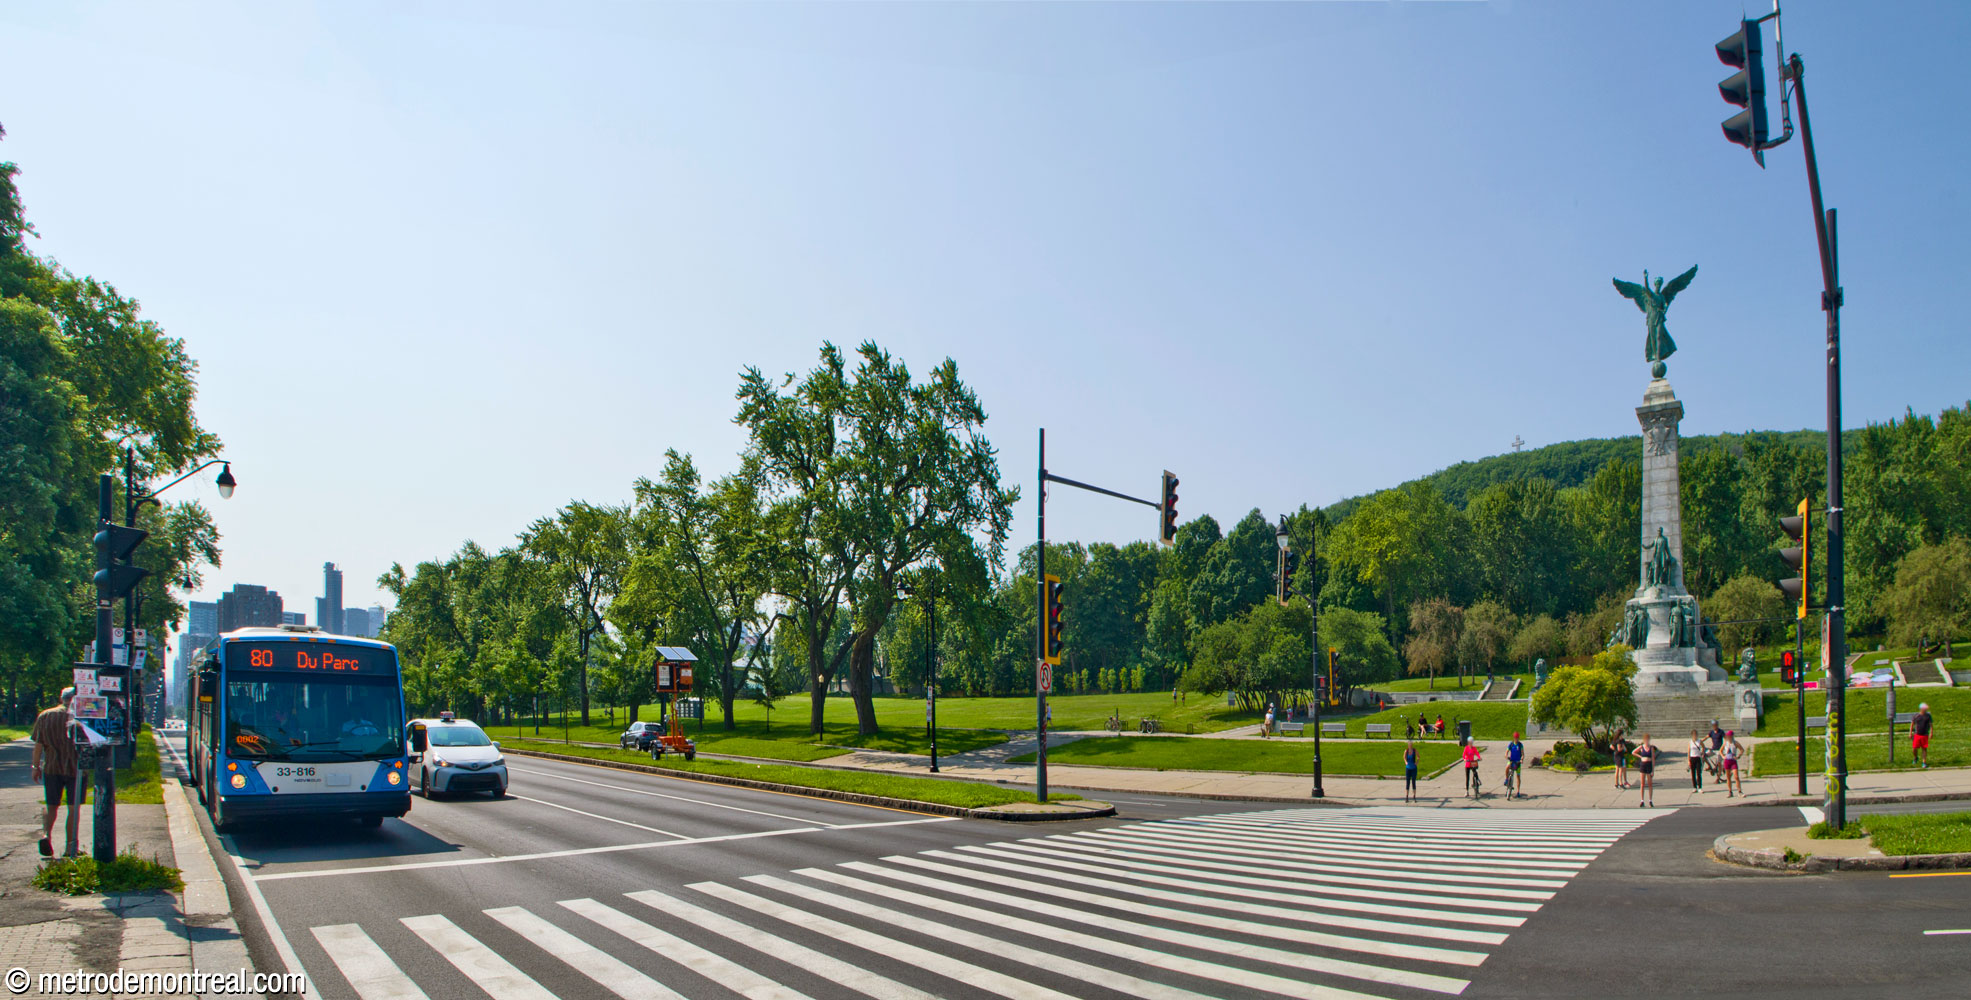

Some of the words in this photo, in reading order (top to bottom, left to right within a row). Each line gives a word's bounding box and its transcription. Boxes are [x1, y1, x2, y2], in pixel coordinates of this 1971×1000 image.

[250, 649, 273, 667] 80
[297, 651, 318, 669] Du
[322, 652, 359, 671] Parc
[276, 767, 316, 777] 33-816
